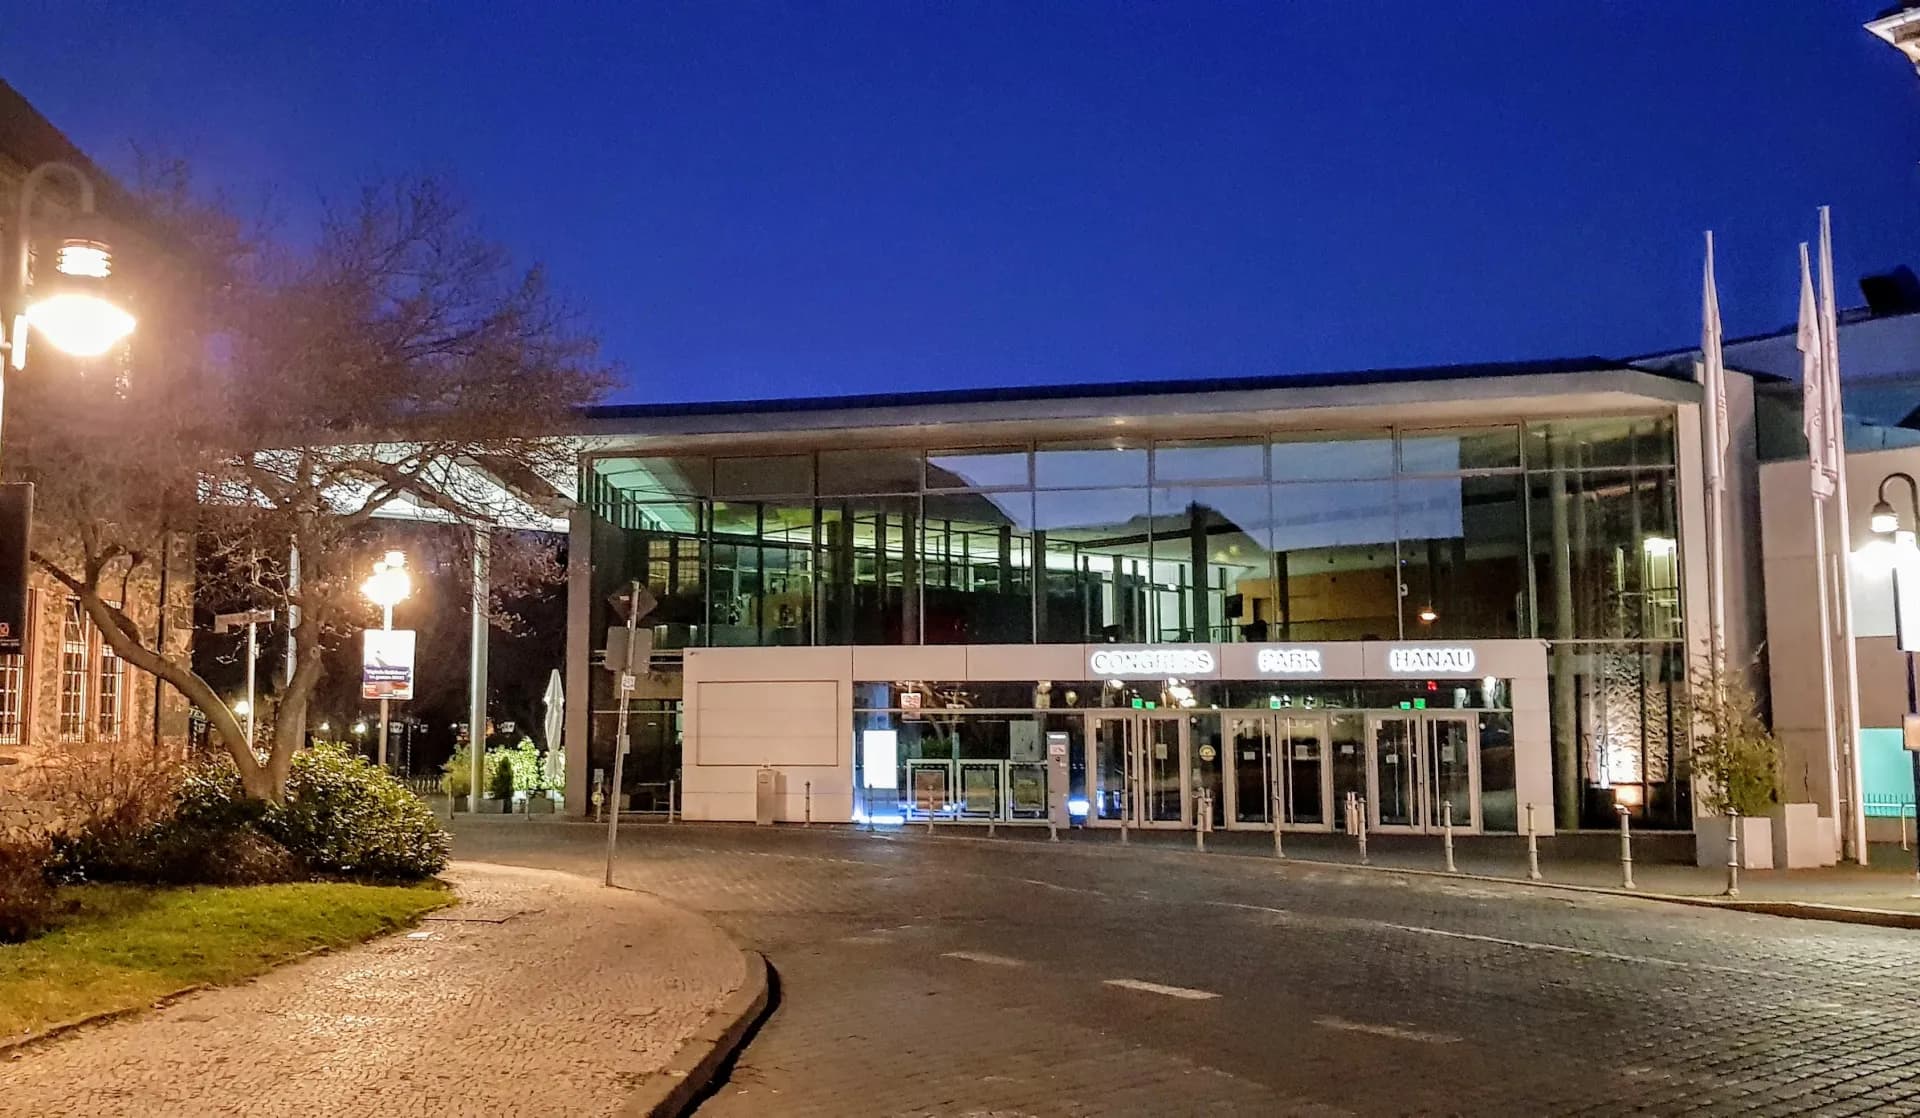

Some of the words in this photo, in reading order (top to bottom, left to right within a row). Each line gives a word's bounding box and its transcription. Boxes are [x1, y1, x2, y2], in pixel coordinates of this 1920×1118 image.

[1093, 653, 1211, 671] CONGRESS
[1261, 651, 1319, 670] PARK
[1393, 650, 1472, 669] HANAU
